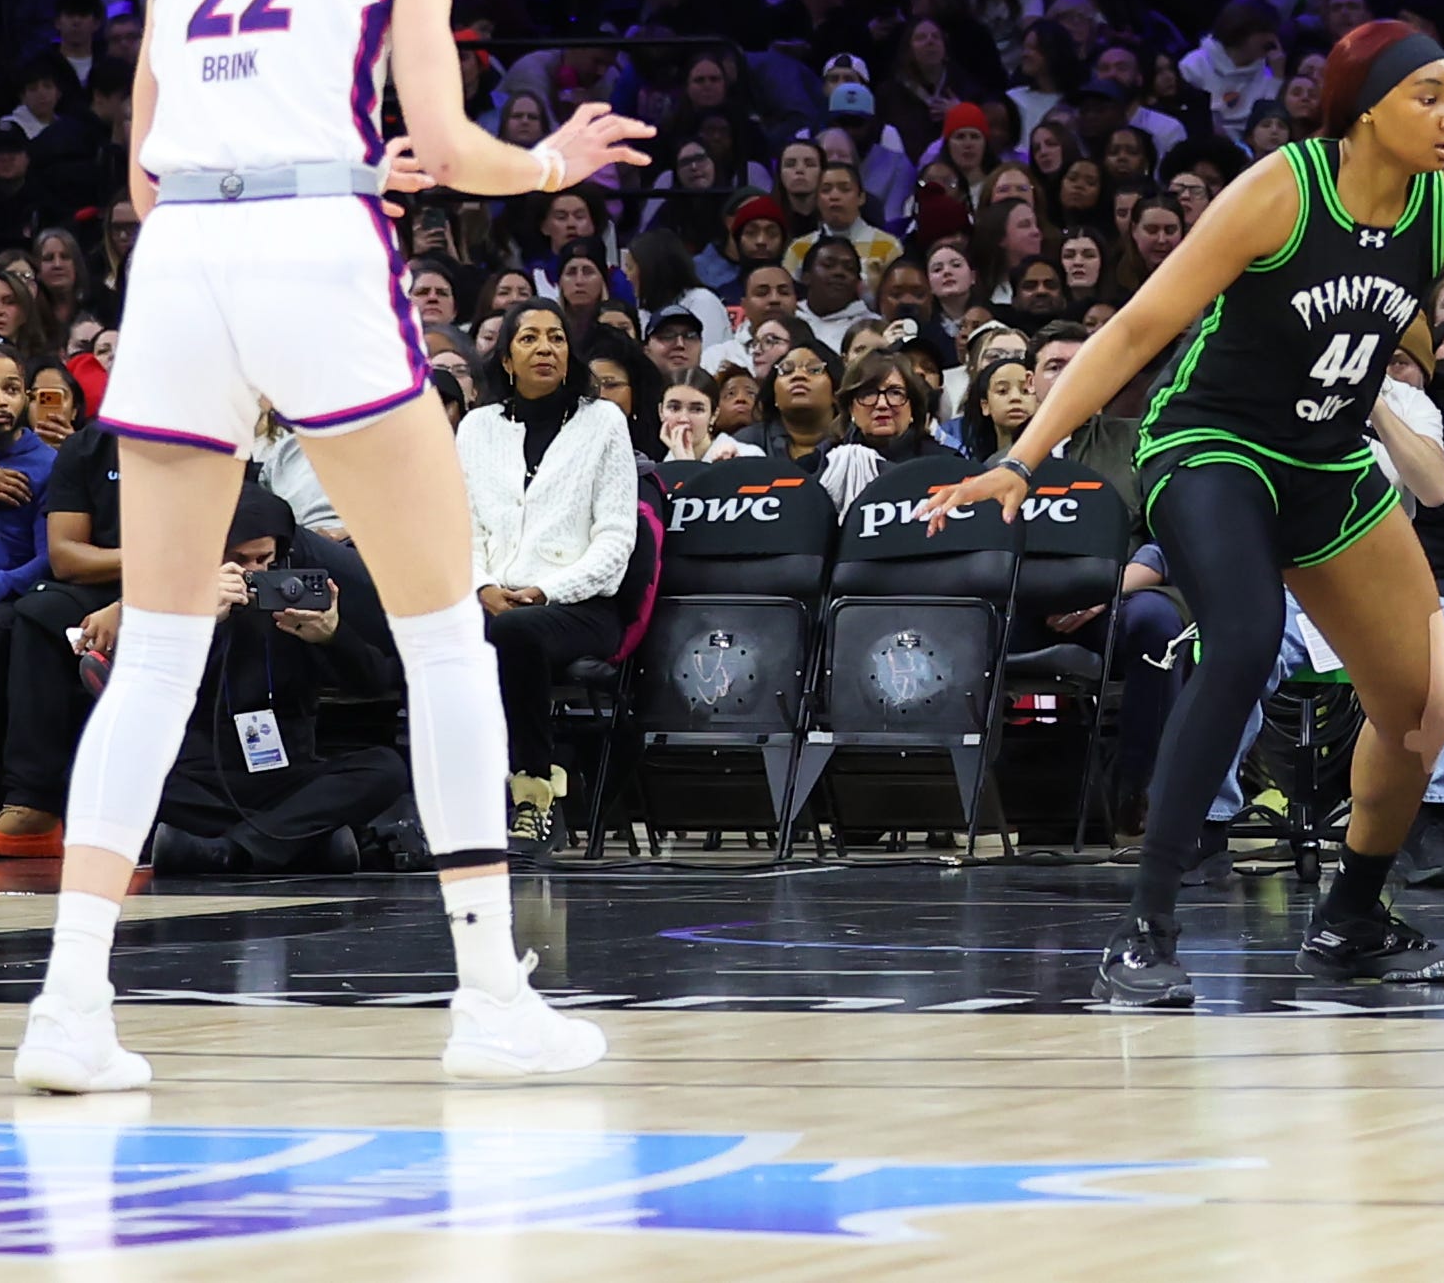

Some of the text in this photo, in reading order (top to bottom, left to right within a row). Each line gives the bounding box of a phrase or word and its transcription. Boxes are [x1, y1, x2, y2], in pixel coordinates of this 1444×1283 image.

[201, 48, 260, 83] BRINK
[1290, 274, 1419, 333] PHANTOM
[1308, 332, 1381, 388] 44
[667, 493, 781, 533] pwc
